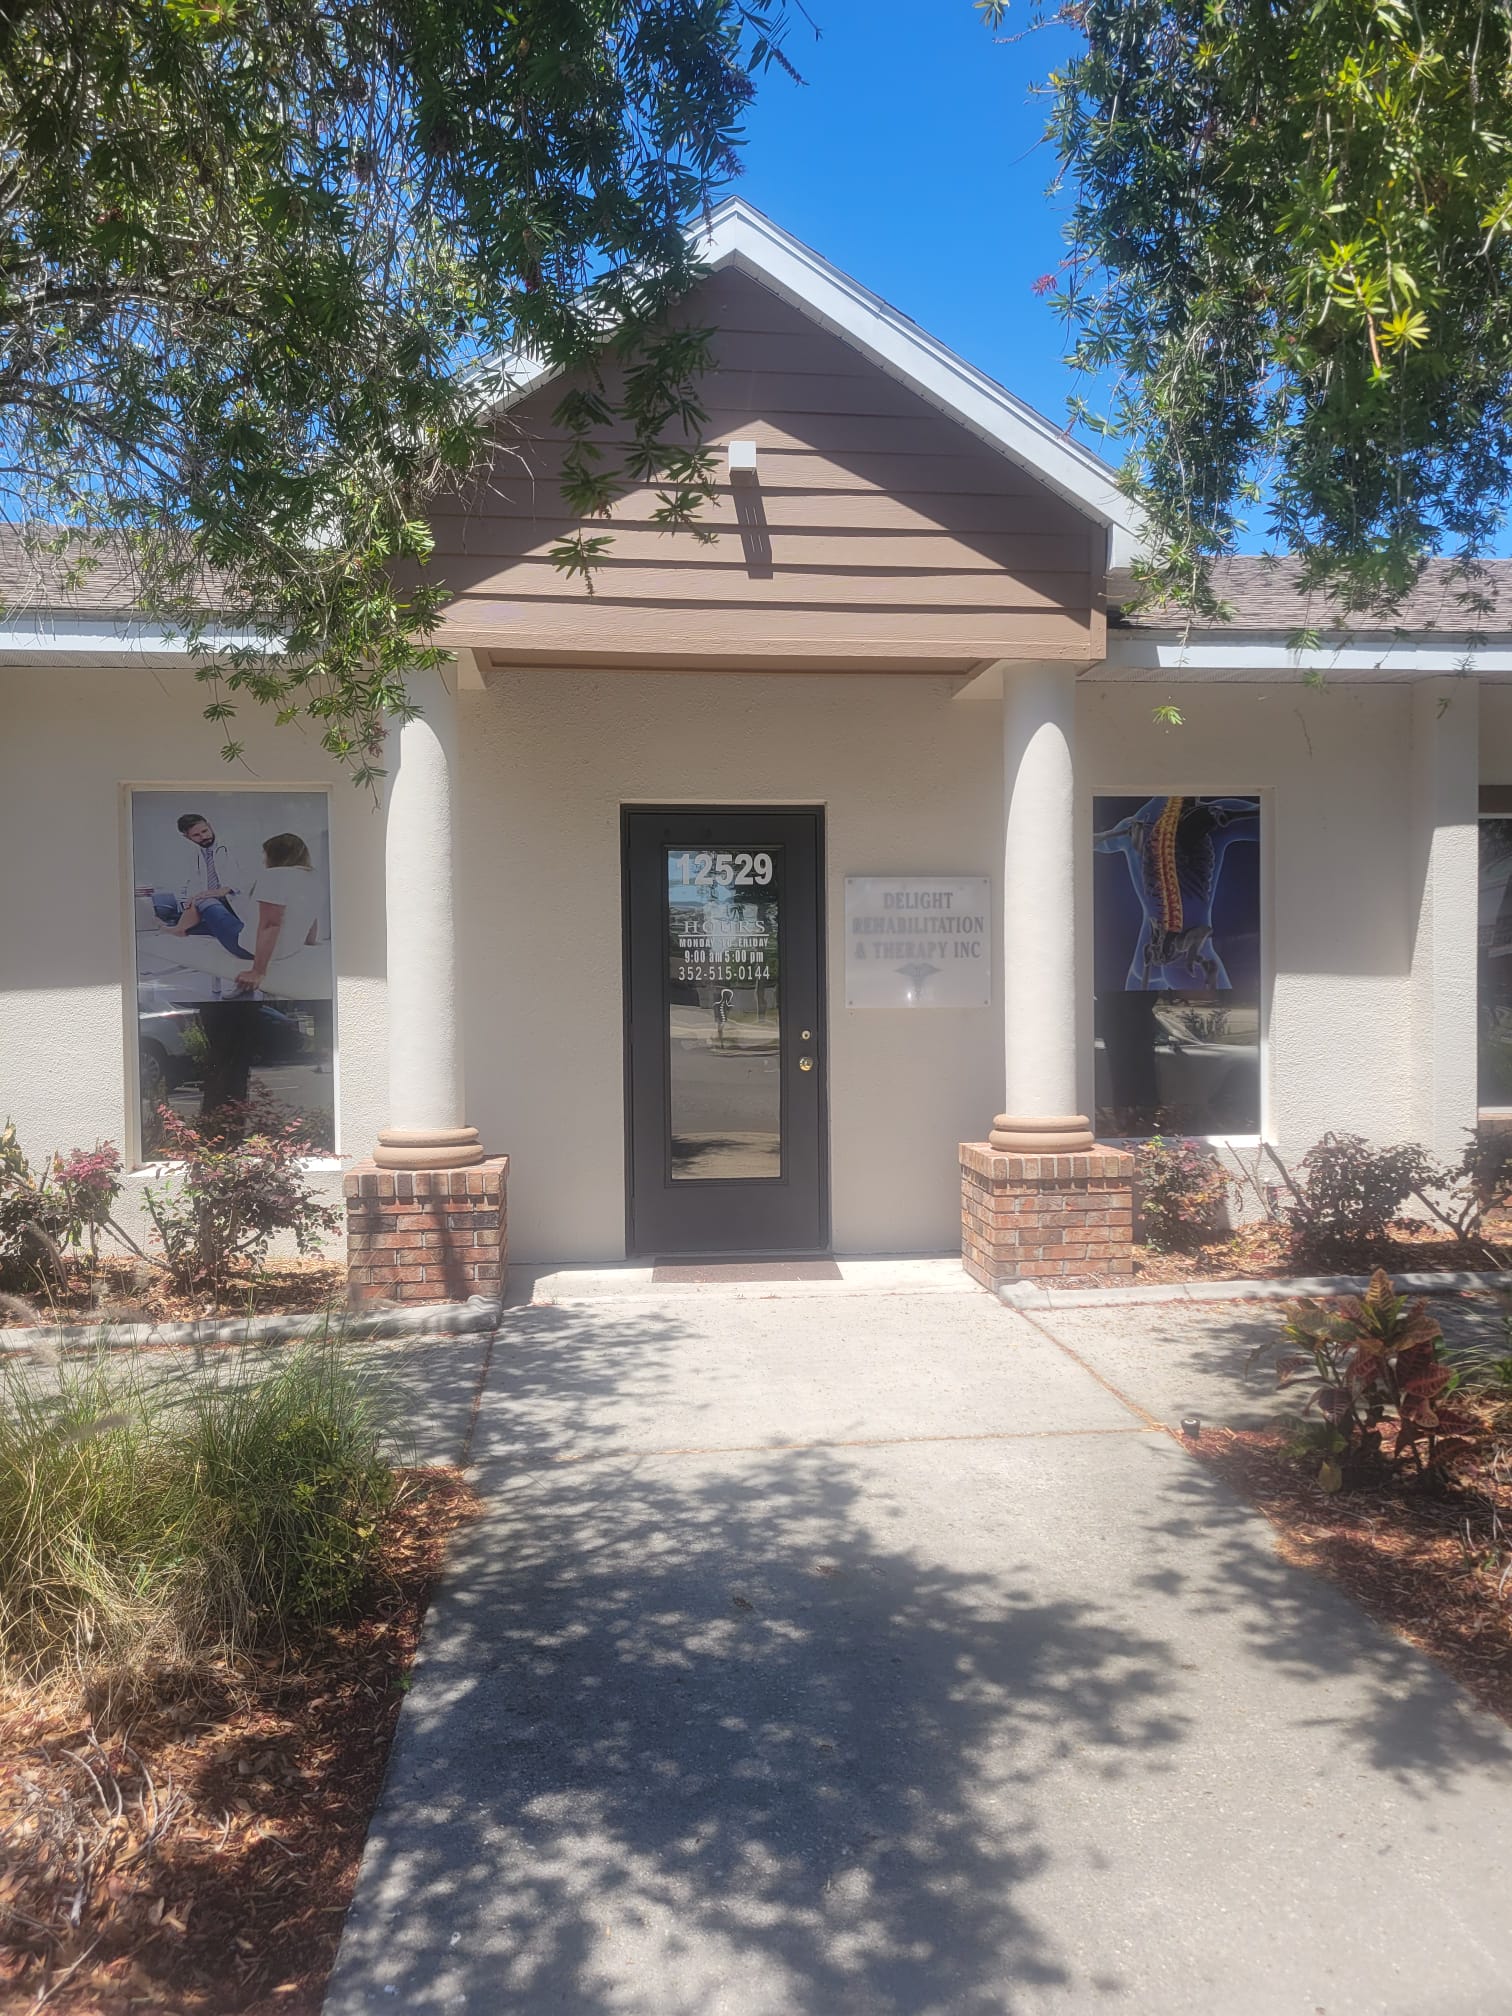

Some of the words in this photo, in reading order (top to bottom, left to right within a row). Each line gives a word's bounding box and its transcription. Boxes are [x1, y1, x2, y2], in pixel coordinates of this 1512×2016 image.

[677, 853, 773, 886] 12529
[882, 892, 954, 909] DELIGHT
[684, 920, 765, 934] HOURS
[851, 916, 984, 934] REHABILITATION
[679, 938, 714, 948] MONDAY
[739, 938, 768, 948] FRIDAY
[872, 941, 948, 959] THERAPY
[953, 941, 981, 958] INC
[684, 950, 705, 963] 9:00
[709, 952, 722, 963] am
[750, 951, 764, 964] pm
[678, 966, 770, 981] 352-515-0144
